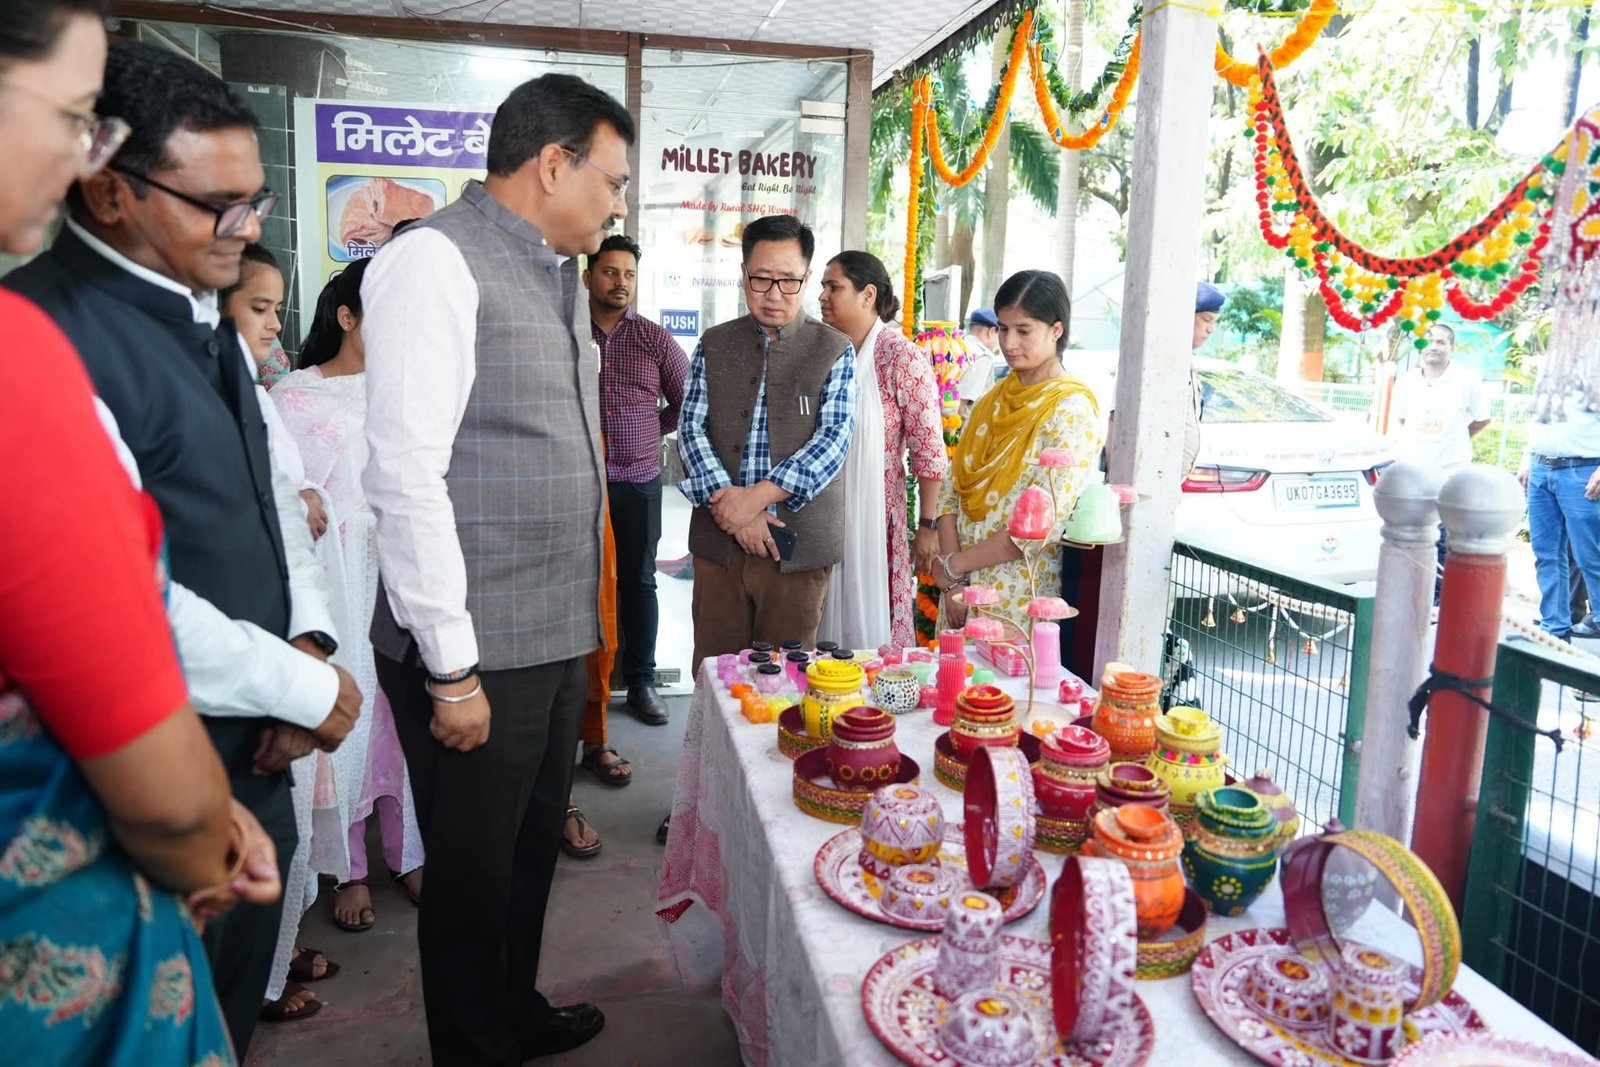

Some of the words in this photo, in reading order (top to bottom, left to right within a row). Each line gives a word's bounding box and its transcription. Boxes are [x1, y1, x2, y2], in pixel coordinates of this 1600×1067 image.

[331, 111, 455, 157] मिलेट
[738, 150, 818, 179] BAKERY
[782, 184, 794, 194] Be
[795, 184, 817, 196] Right
[680, 200, 705, 211] Made
[707, 201, 718, 213] by
[720, 202, 744, 213] Rural
[747, 203, 766, 215] SHG
[768, 205, 800, 215] Women
[663, 314, 696, 330] PUSH
